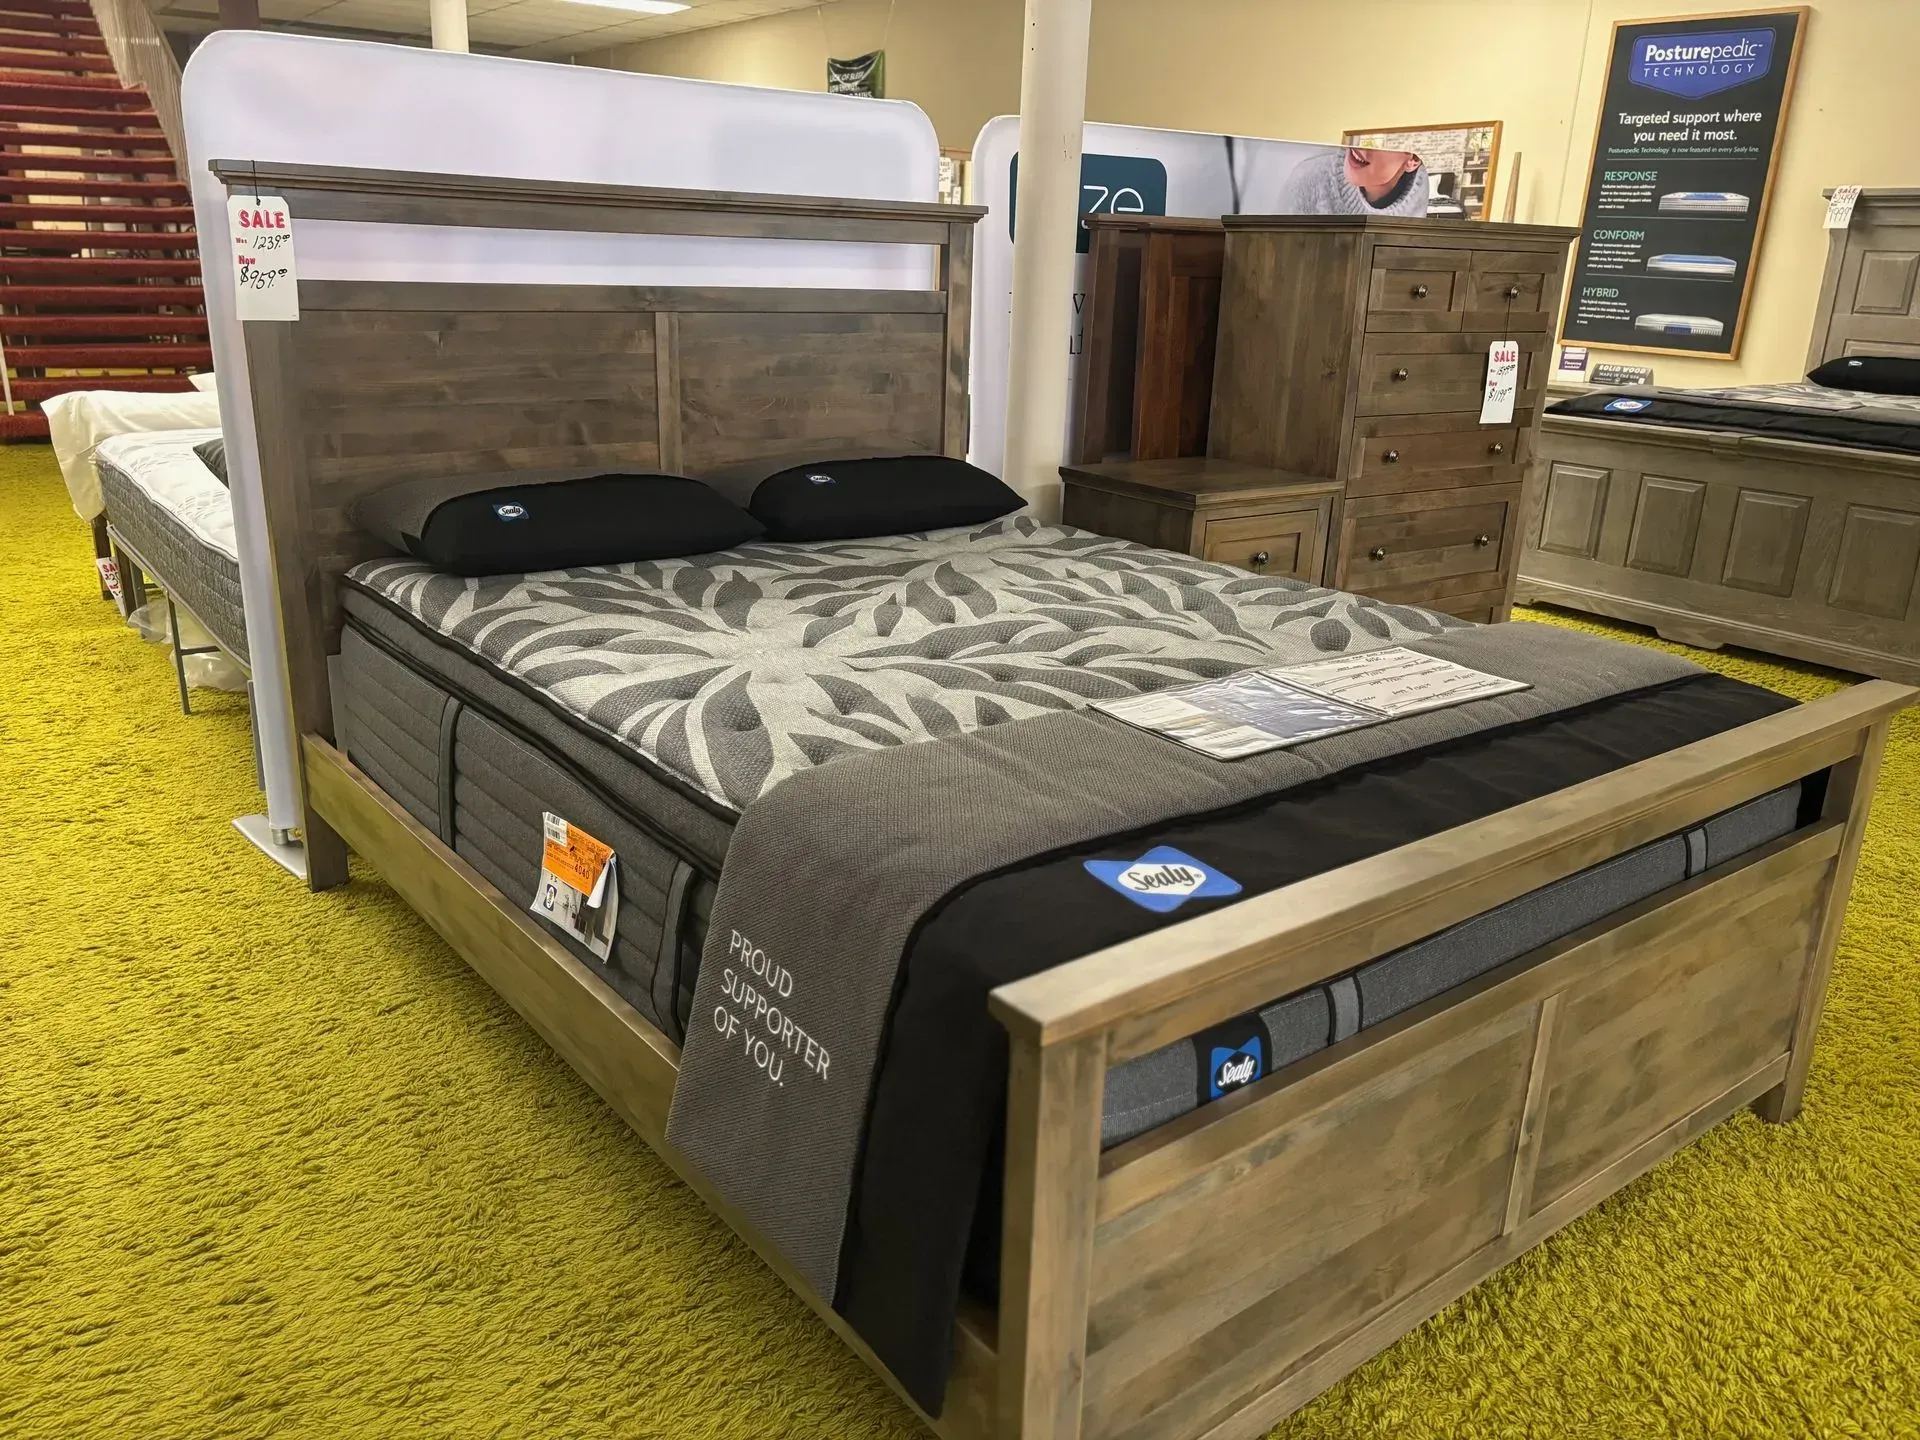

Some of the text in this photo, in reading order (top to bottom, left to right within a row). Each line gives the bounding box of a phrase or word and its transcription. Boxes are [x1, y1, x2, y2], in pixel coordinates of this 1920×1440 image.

[1644, 38, 1757, 64] Posturepedic
[1643, 64, 1754, 77] TECHNOLOGY
[1619, 109, 1762, 127] Targeted support where
[1633, 128, 1738, 144] you need it most.
[1718, 147, 1733, 155] every
[1734, 146, 1748, 154] Sealy
[1604, 171, 1658, 181] RESPONSE
[239, 210, 285, 228] SALE
[1593, 229, 1645, 241] CONFORM
[238, 254, 256, 265] Now
[1582, 287, 1619, 298] HYBRID
[1494, 350, 1516, 362] SALE
[1599, 364, 1646, 374] SOLID WOOD
[501, 506, 521, 515] Sealy
[574, 863, 590, 880] 4040
[1127, 864, 1196, 892] Sealy
[729, 929, 793, 997] PROUD
[721, 968, 830, 1080] SUPPORTER
[714, 1006, 784, 1087] OF YOU.
[1217, 1055, 1255, 1087] Sealy
